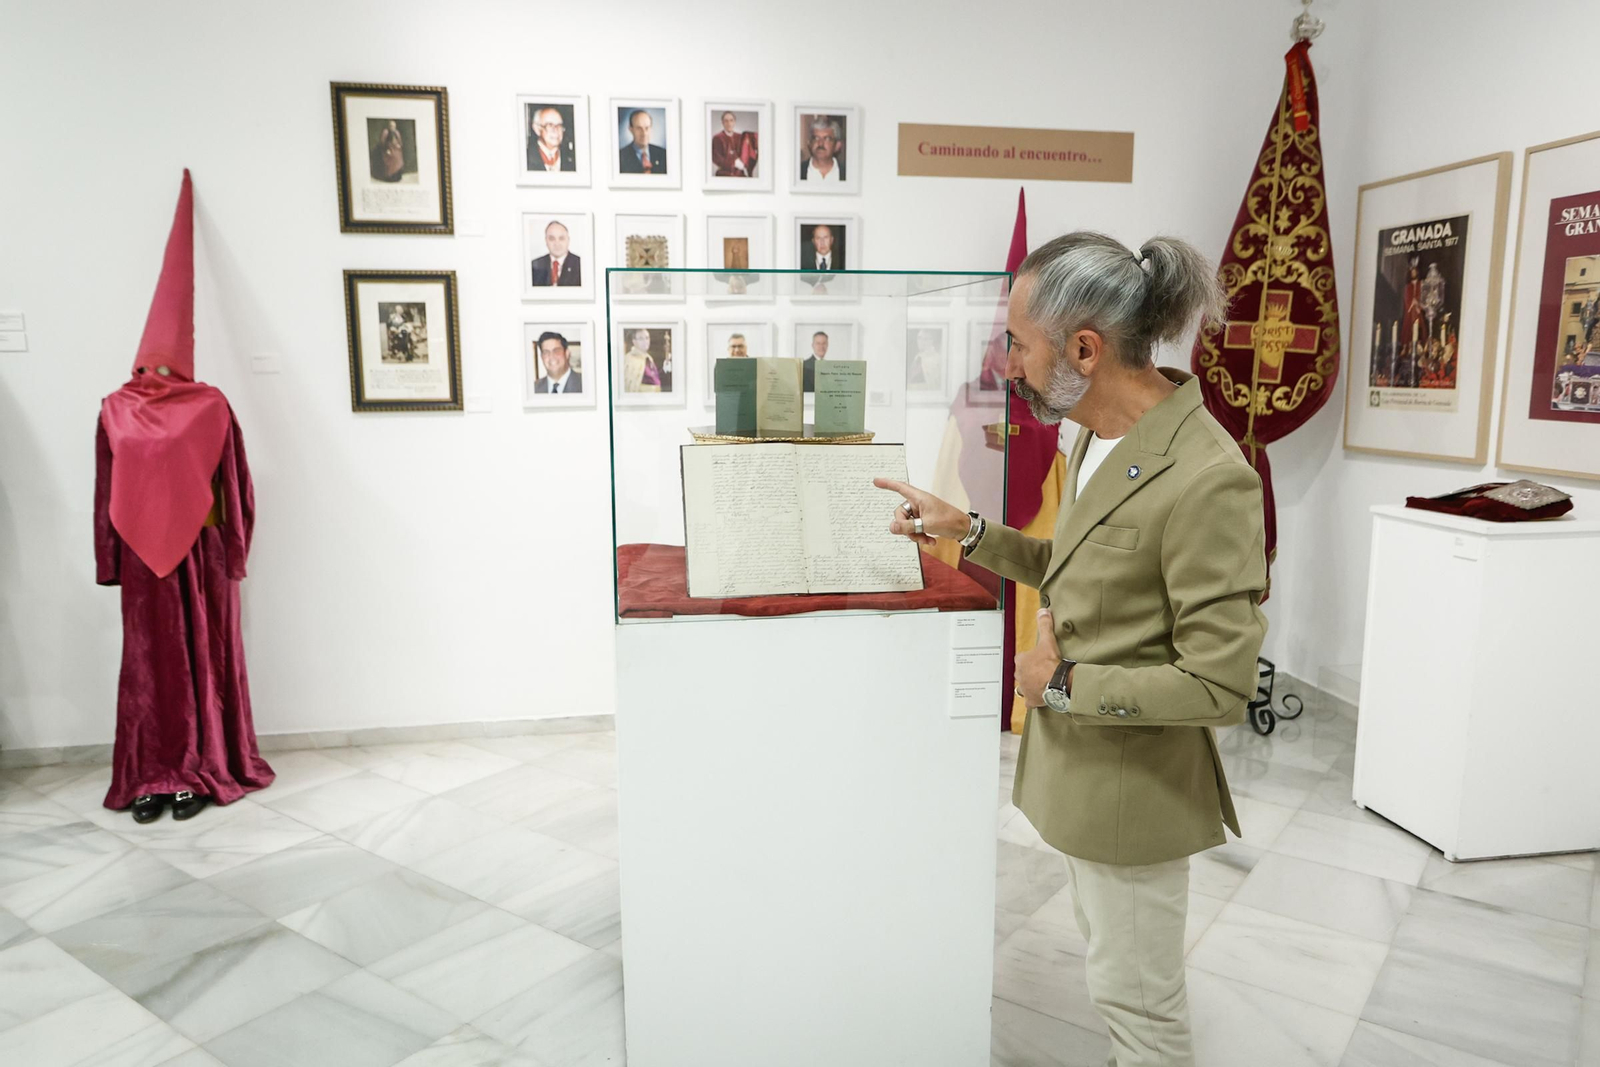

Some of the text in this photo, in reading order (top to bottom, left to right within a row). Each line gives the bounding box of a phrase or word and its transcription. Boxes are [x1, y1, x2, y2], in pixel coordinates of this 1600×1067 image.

[918, 141, 1102, 163] Caminando al encuentro...
[1560, 203, 1600, 222] SEMA
[1391, 221, 1453, 246] GRANADA
[1383, 243, 1415, 257] SEMANA
[1417, 239, 1443, 252] SANTA
